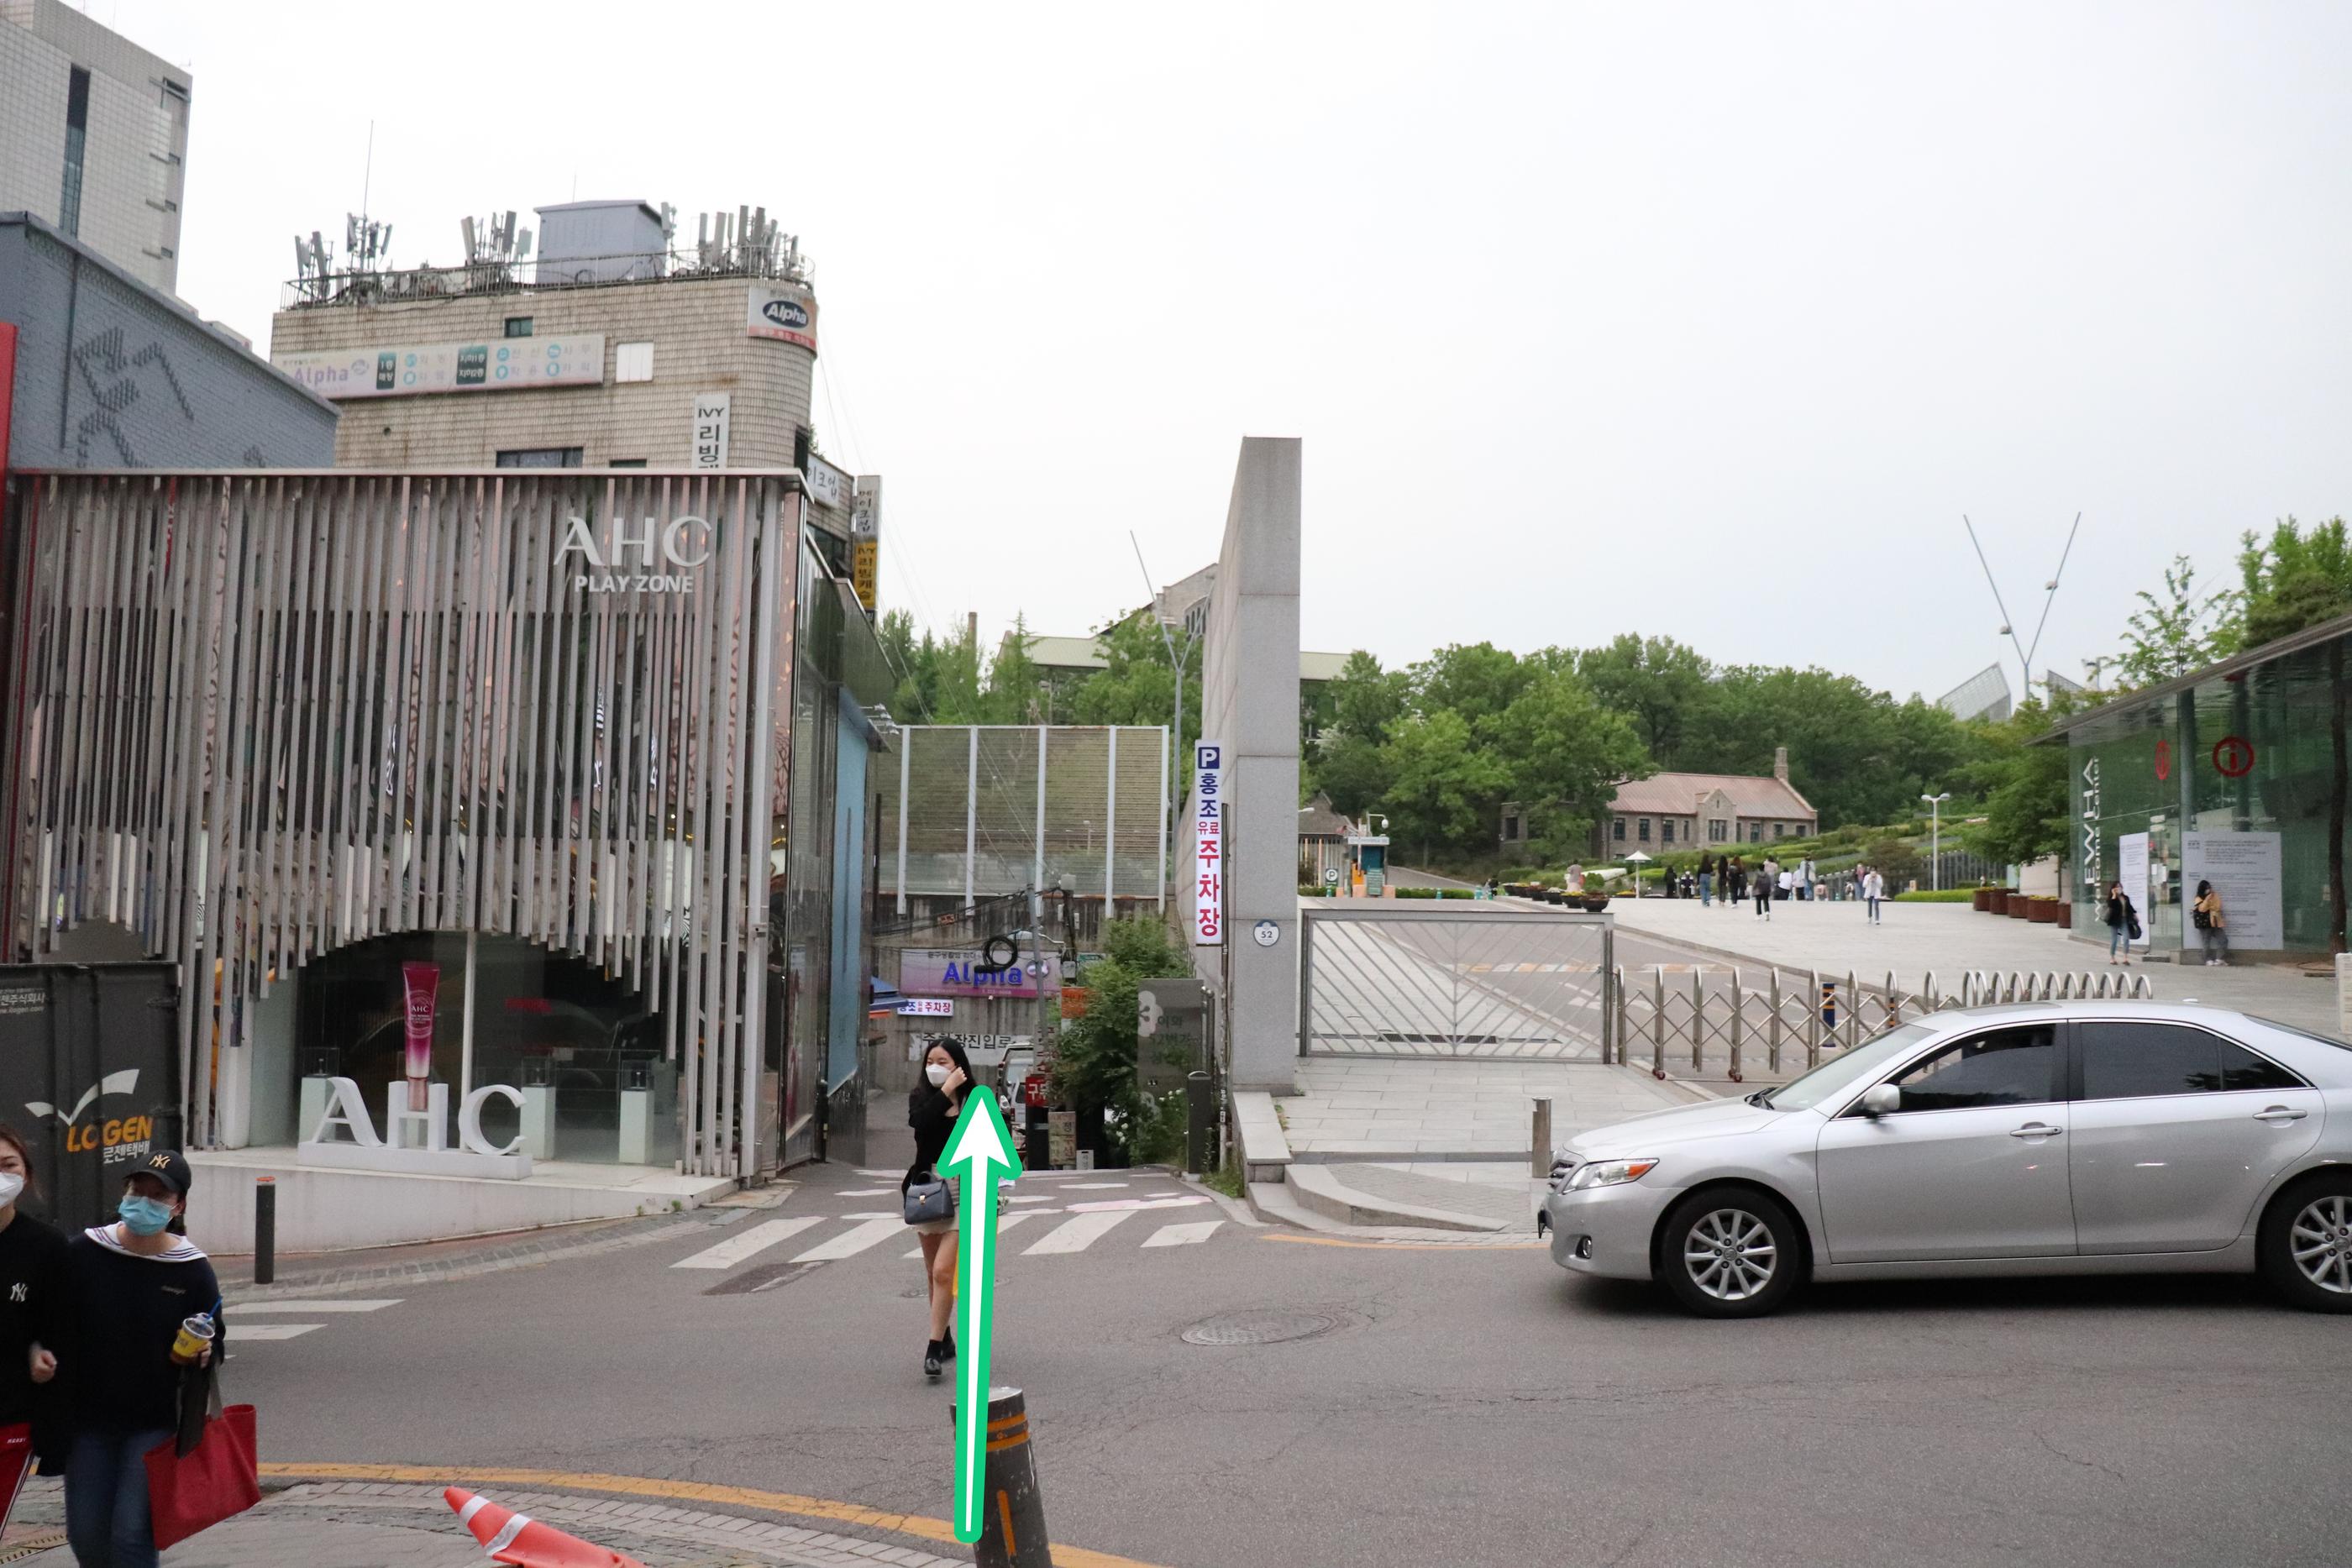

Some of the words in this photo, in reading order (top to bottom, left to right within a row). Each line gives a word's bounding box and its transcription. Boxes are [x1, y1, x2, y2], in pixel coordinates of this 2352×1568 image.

[766, 303, 806, 324] Alpha
[295, 366, 349, 385] Alpha
[699, 407, 724, 418] IVY
[699, 424, 720, 468] 리빙
[554, 515, 712, 567] AHC
[575, 575, 629, 593] PLAY
[636, 575, 694, 593] ZONE
[1200, 773, 1218, 818] 홍조
[1198, 821, 1220, 836] 유료
[2083, 758, 2096, 884] EWHA
[1198, 840, 1220, 937] 주차장
[942, 962, 1022, 988] Alpha
[925, 1001, 951, 1013] 주차장
[312, 1077, 528, 1156] AHC
[66, 1115, 154, 1153] LOGEN
[103, 1140, 150, 1164] 로젠택배
